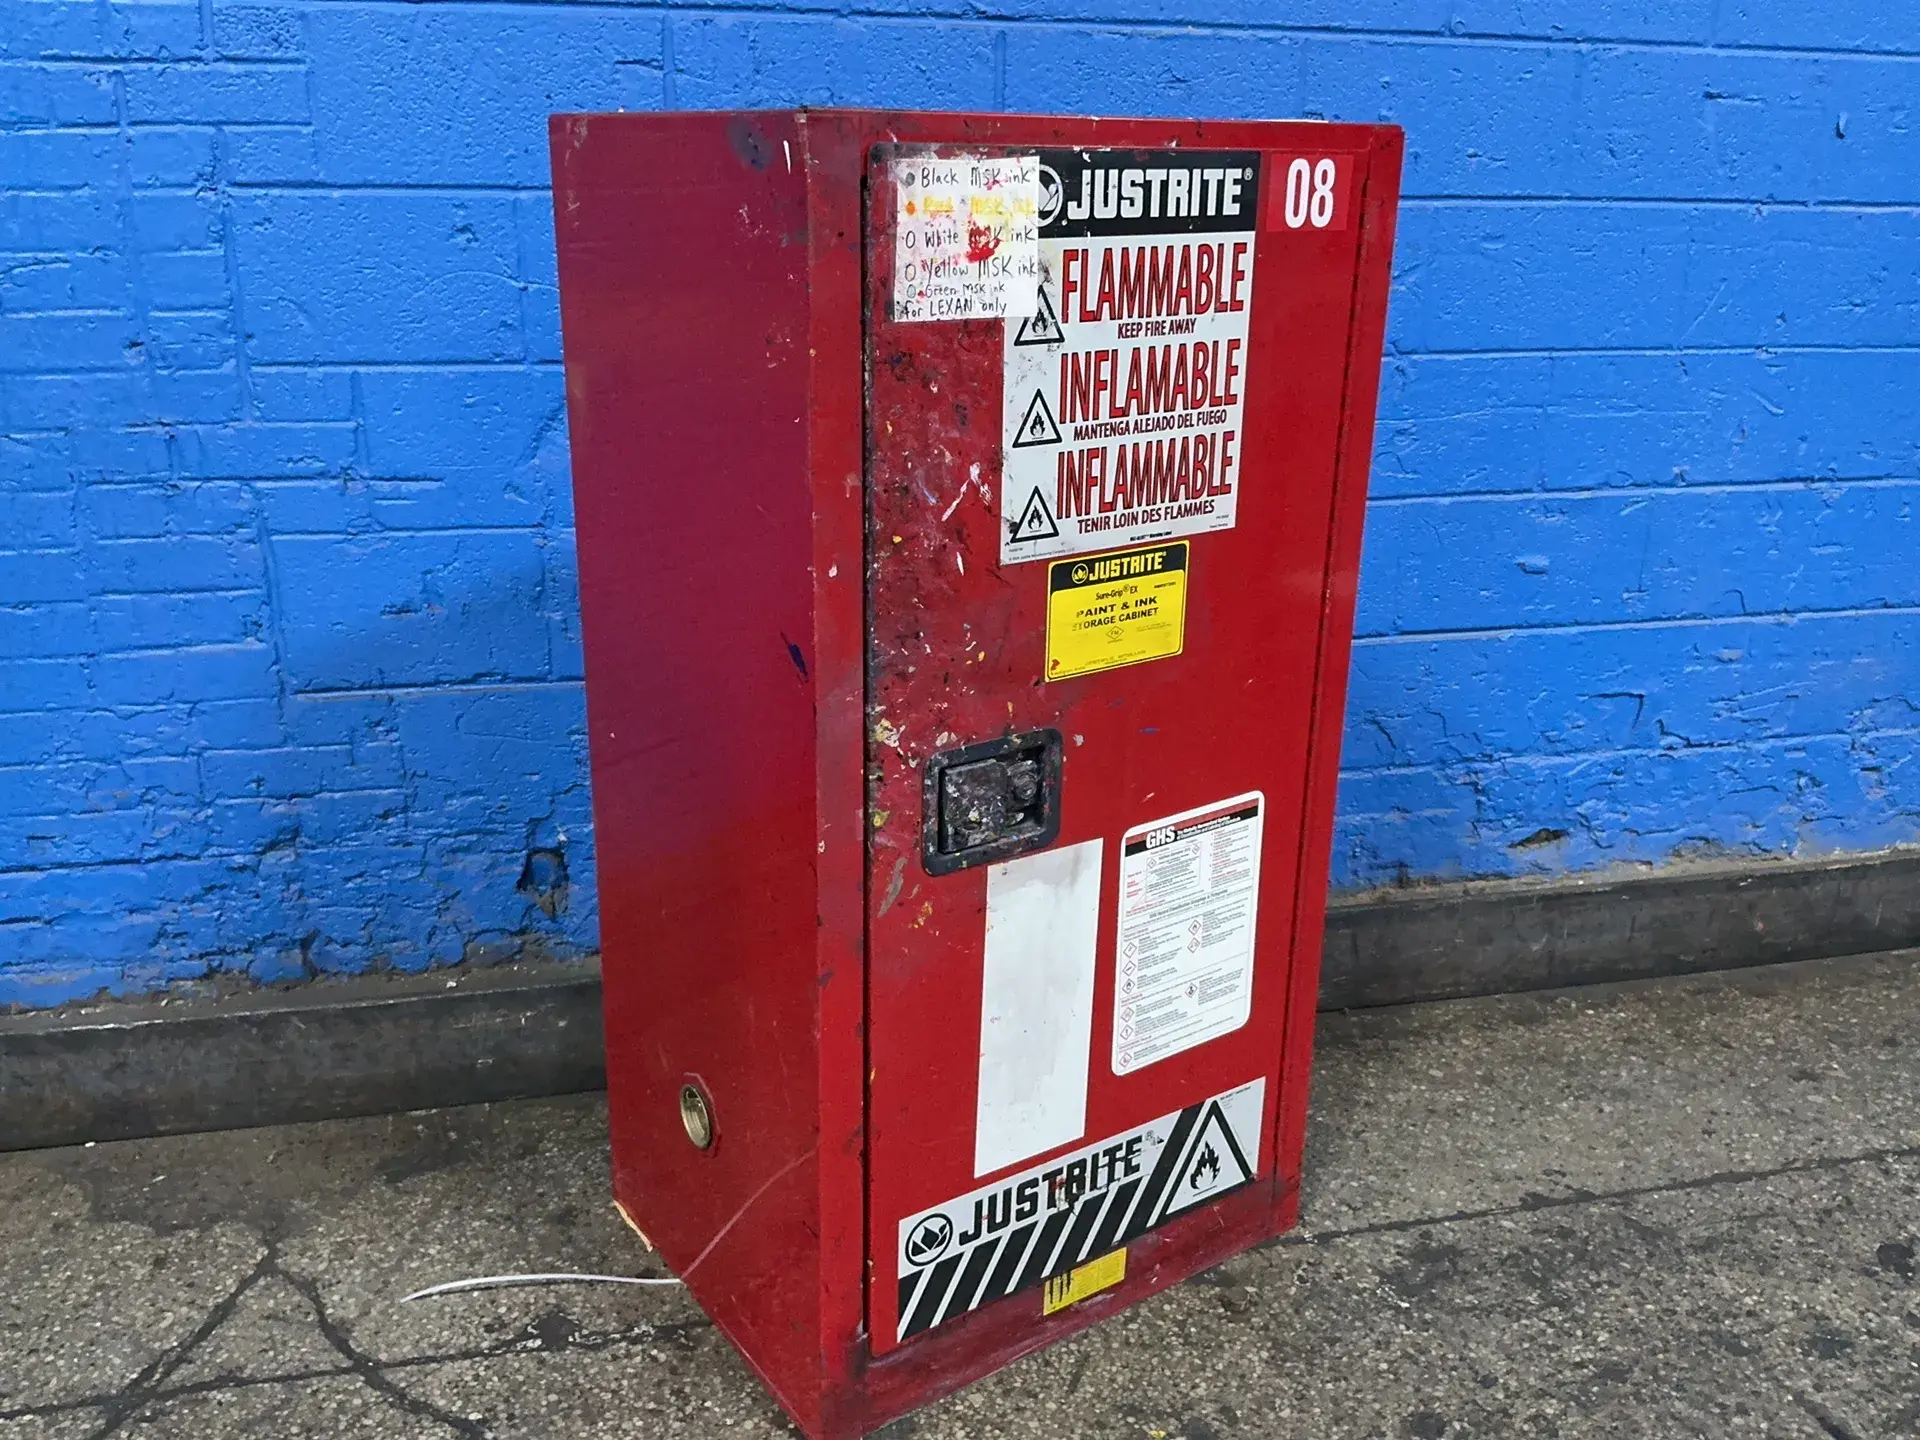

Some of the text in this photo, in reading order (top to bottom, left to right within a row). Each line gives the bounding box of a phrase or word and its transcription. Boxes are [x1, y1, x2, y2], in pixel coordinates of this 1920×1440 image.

[921, 166, 1031, 188] Black MSK ink
[1284, 158, 1336, 229] 08
[924, 229, 959, 248] White
[1011, 225, 1036, 244] ink
[926, 255, 1038, 283] Yellow MSK ink
[925, 282, 1006, 298] Green MSK ink
[1060, 241, 1248, 323] FLAMMABLE
[904, 296, 1008, 319] for LEXAN only
[1117, 318, 1197, 339] KEEP FIRE AWAY
[1058, 338, 1241, 425] INFLAMABLE
[1073, 408, 1228, 441] MANTENGA ALEJADO DEL FUEGO
[1056, 430, 1236, 519] INFLAMMABLE
[1077, 514, 1111, 534] TENIR
[1113, 510, 1140, 529] LOIN
[1142, 507, 1163, 525] DES
[1164, 499, 1215, 522] FLAMMES
[1129, 585, 1139, 595] EX
[1118, 607, 1160, 622] CABINET
[1120, 601, 1130, 611] &
[1134, 595, 1158, 608] INK
[1145, 825, 1176, 849] GHS
